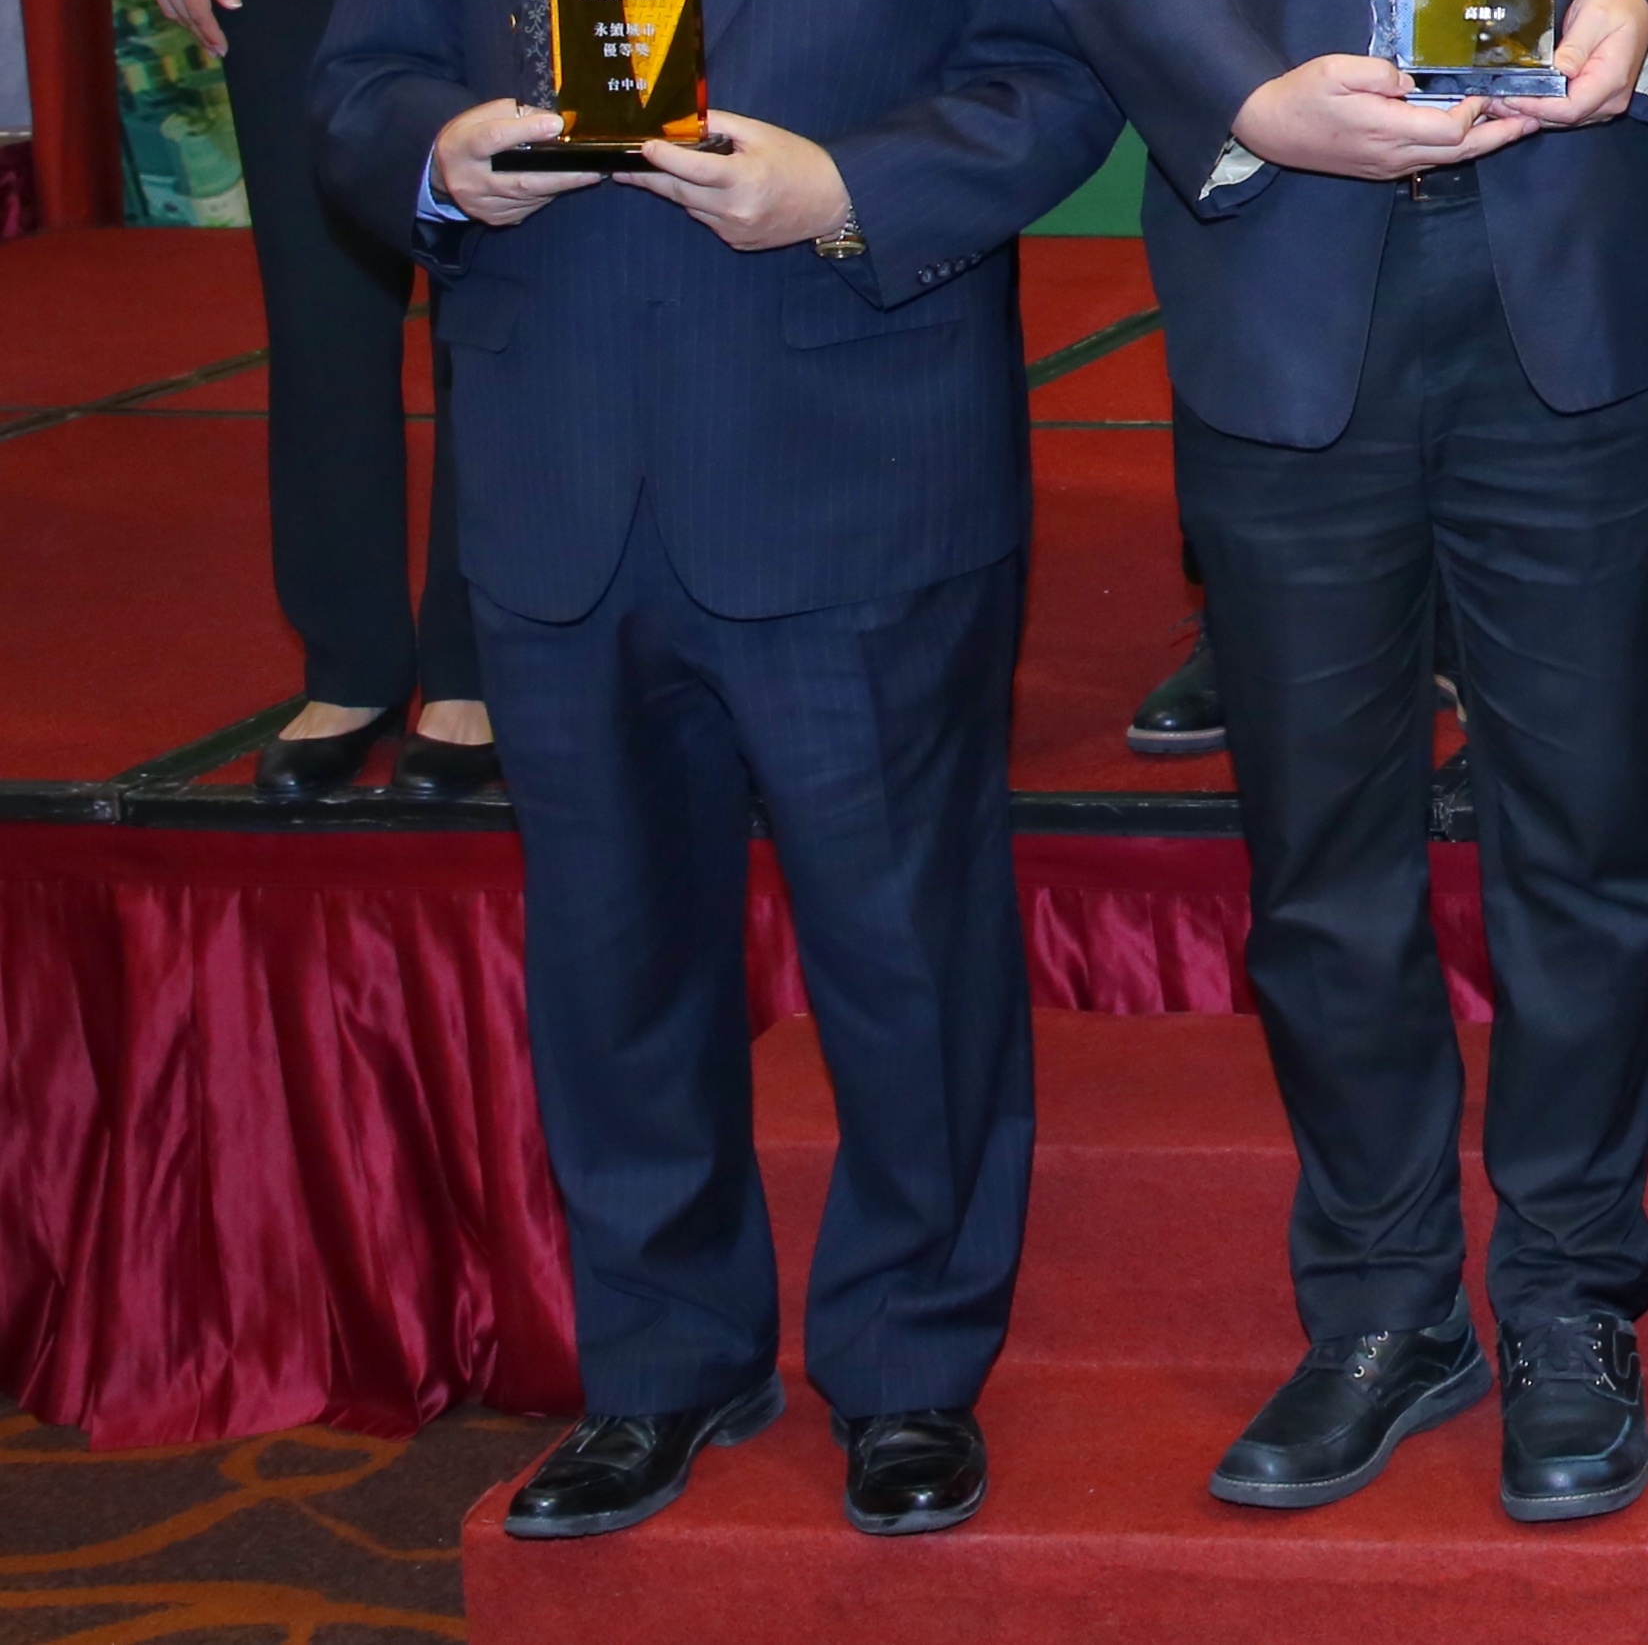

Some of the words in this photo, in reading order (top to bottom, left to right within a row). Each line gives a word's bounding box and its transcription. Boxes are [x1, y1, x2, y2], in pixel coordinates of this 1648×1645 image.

[1464, 7, 1506, 20] 高雄市
[594, 22, 656, 37] 永續城市
[603, 42, 650, 57] 優等獎
[607, 78, 648, 91] 台中市
